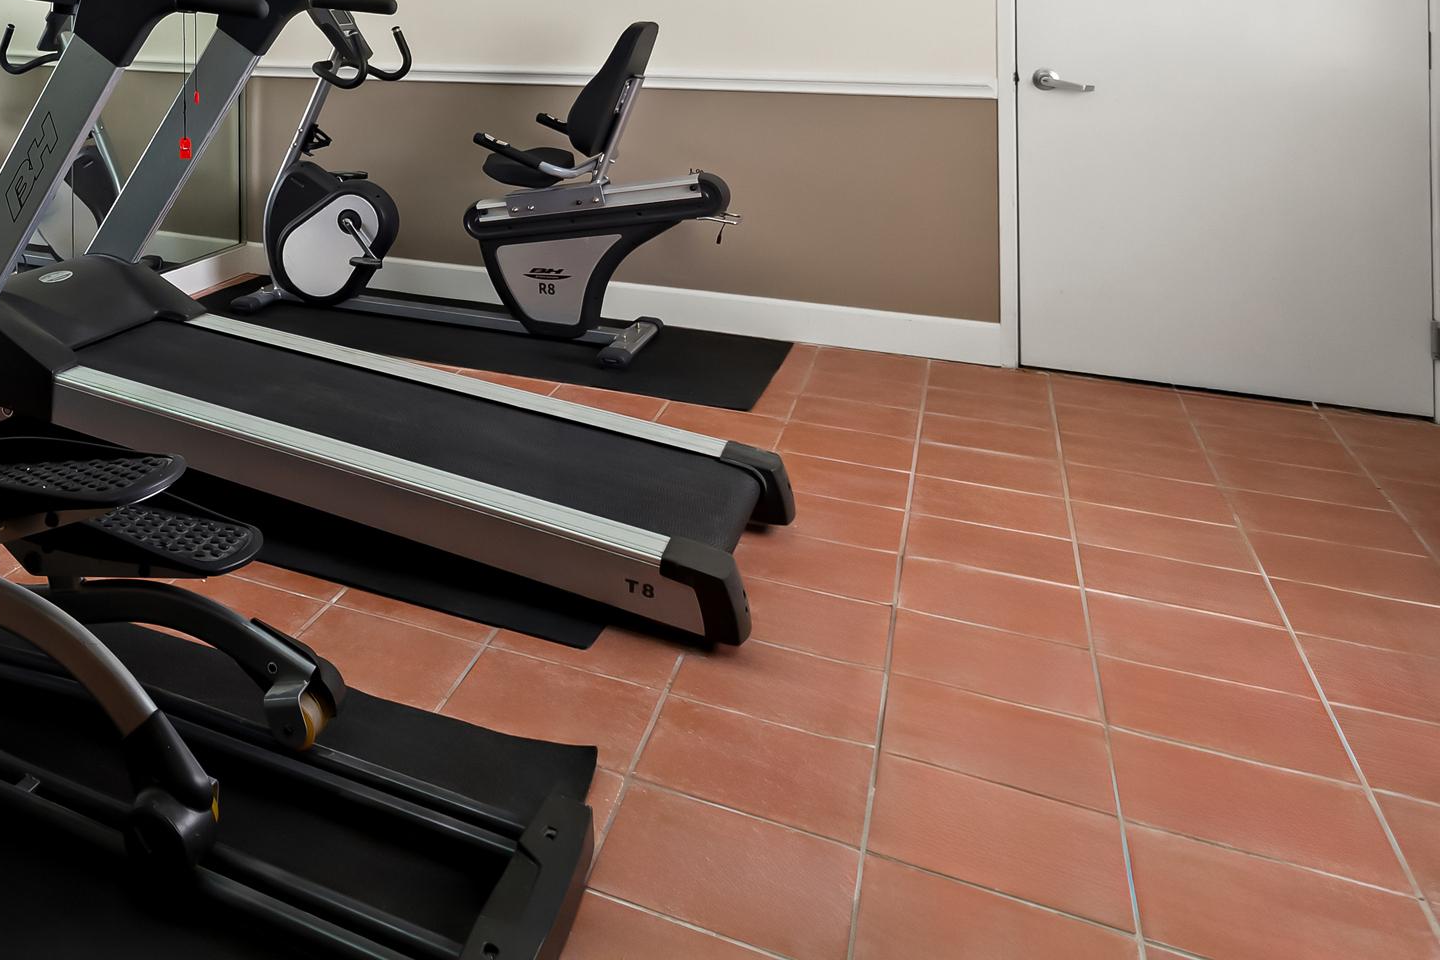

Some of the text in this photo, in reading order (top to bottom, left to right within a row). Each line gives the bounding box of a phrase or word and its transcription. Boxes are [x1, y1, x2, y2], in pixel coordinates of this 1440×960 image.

[5, 111, 59, 223] BH
[539, 282, 555, 295] R8
[625, 578, 655, 599] T8
